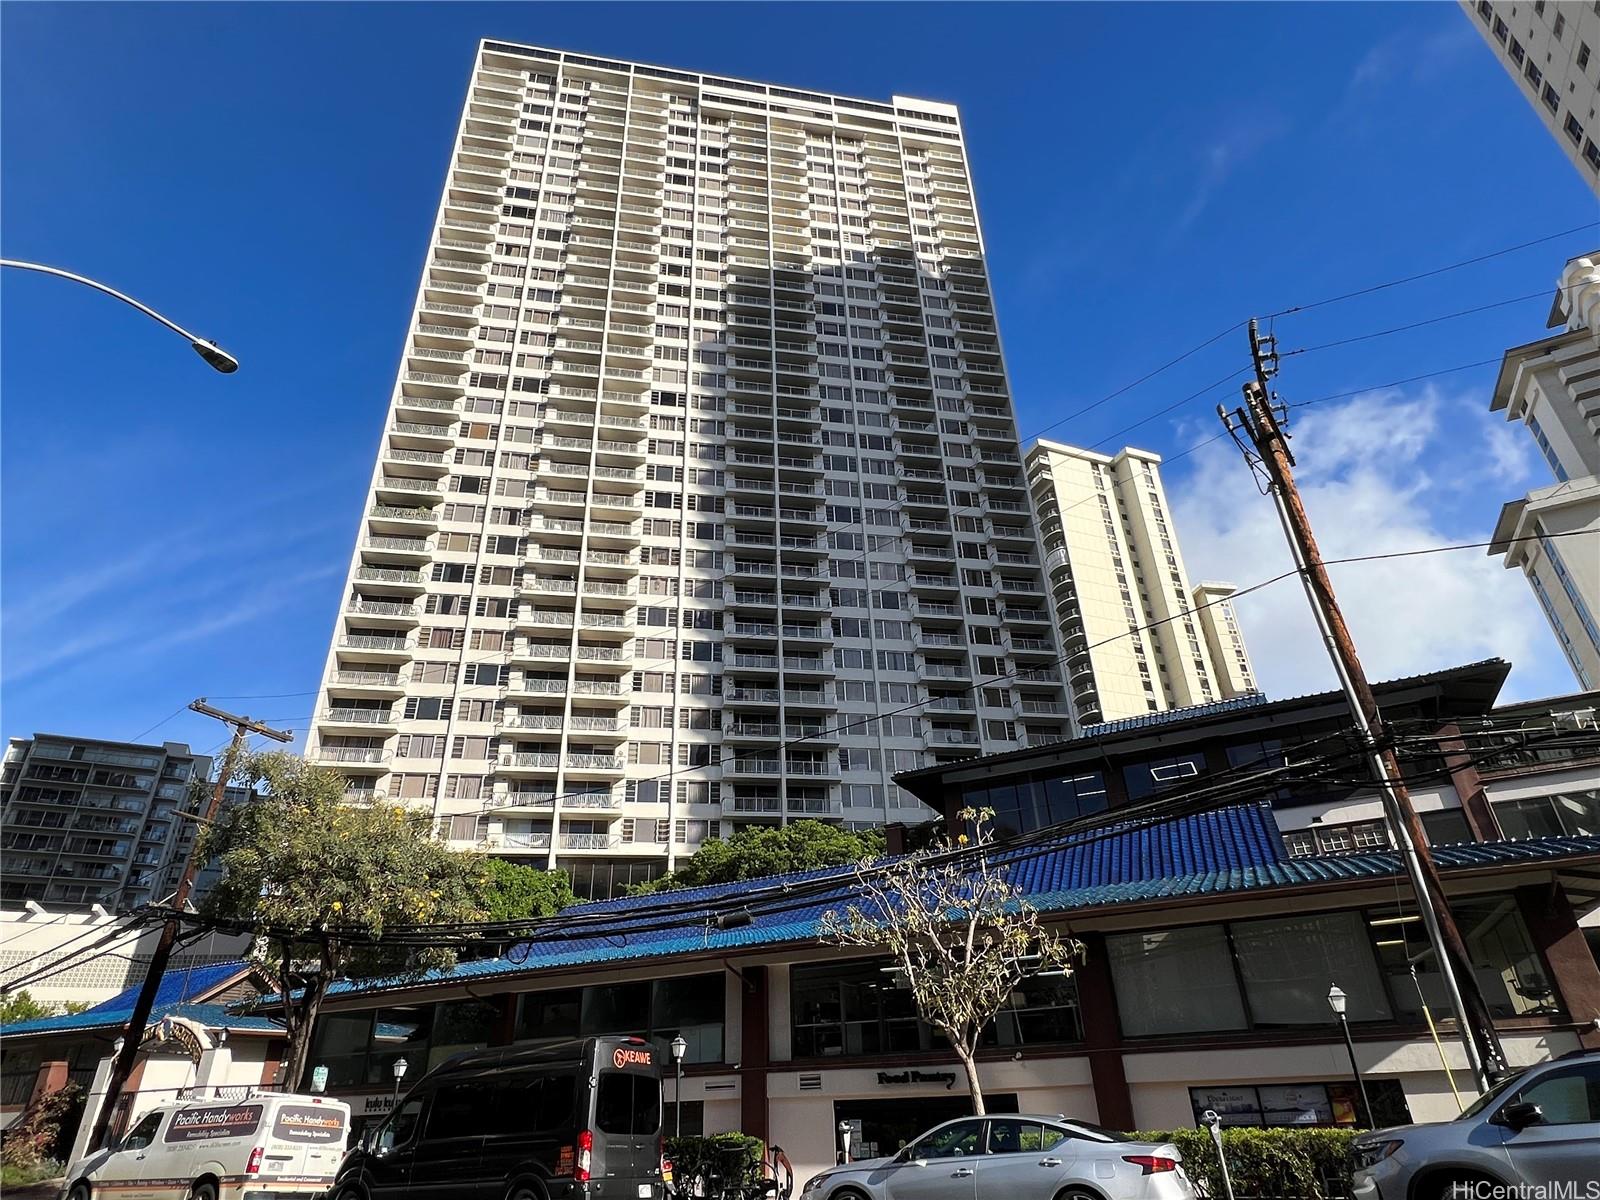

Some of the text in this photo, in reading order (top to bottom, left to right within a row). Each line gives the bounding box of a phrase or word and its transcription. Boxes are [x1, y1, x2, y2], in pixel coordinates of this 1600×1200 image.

[625, 1050, 651, 1065] KEAWE
[877, 1070, 957, 1091] Food Pantry
[175, 1108, 255, 1126] Pacific Handyworks
[281, 1113, 340, 1127] Pacific Handyworks
